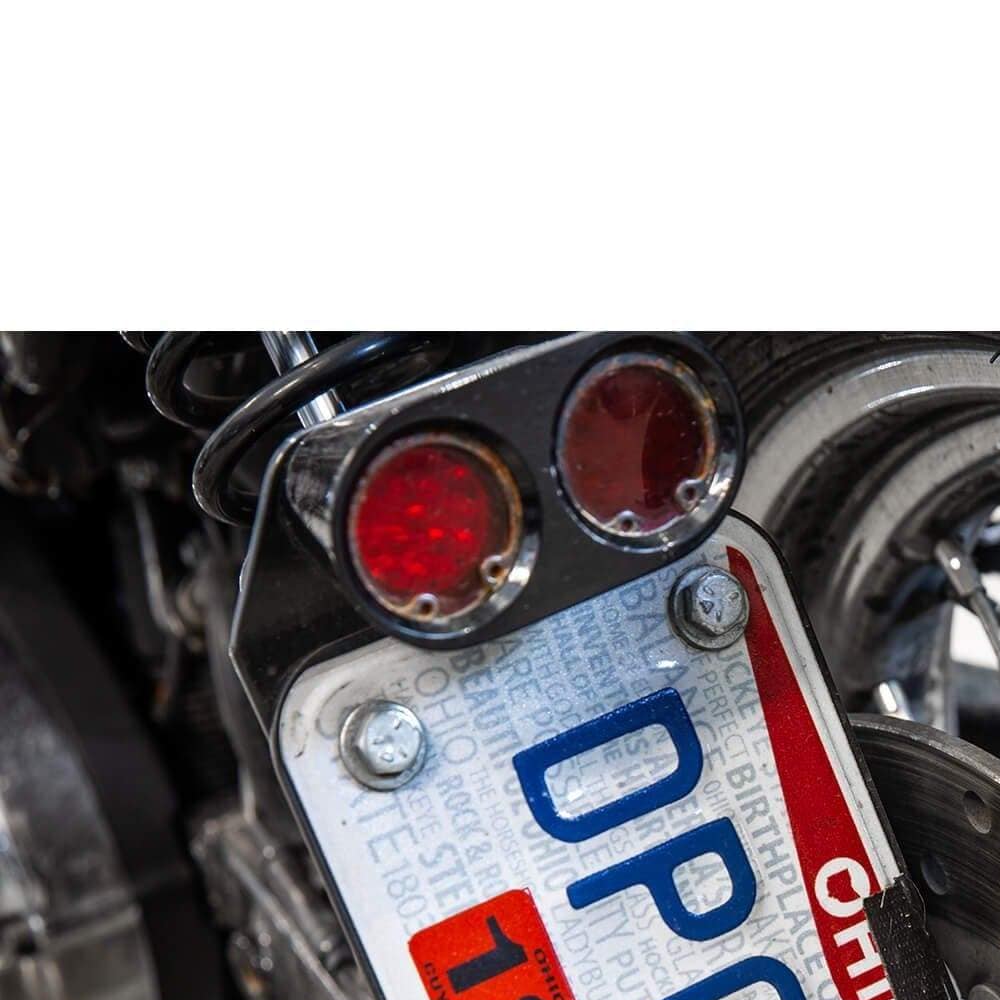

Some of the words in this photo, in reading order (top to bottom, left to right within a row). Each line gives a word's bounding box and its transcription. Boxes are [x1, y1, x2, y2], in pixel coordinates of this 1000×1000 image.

[409, 660, 483, 771] OHIO
[695, 668, 751, 766] PERFECT
[724, 759, 834, 979] BIRTHPLACE
